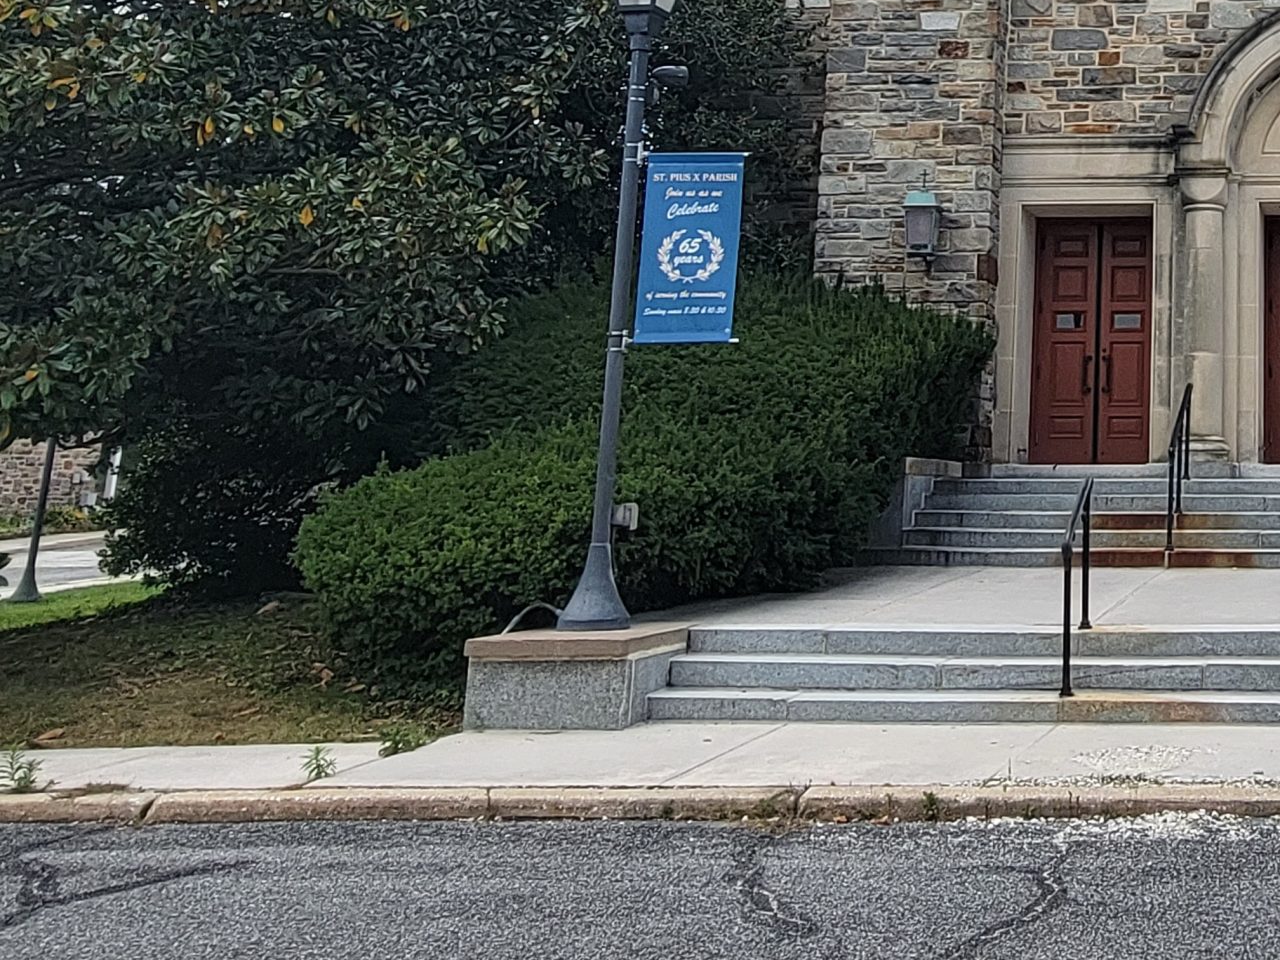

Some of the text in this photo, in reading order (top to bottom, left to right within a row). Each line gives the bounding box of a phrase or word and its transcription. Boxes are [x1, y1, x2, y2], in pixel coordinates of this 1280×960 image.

[670, 173, 691, 182] PIUS
[692, 173, 700, 182] X
[702, 173, 738, 182] PARISH
[665, 186, 684, 200] Join
[667, 201, 720, 220] Celebrate
[679, 238, 703, 253] 65
[673, 254, 704, 267] years
[679, 289, 690, 298] the
